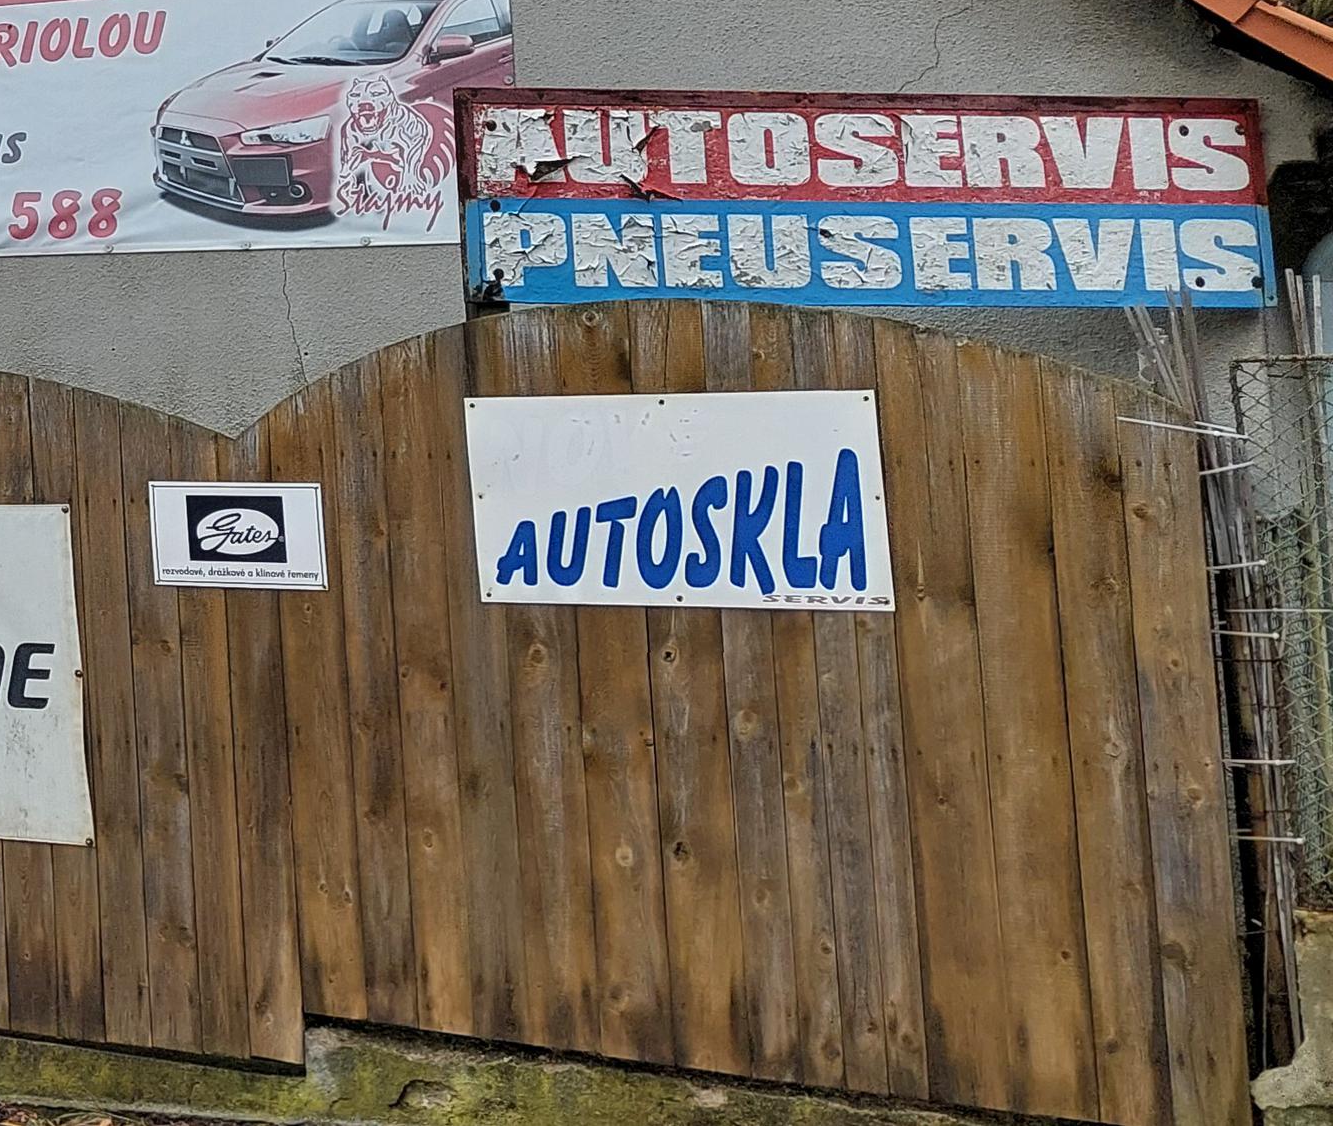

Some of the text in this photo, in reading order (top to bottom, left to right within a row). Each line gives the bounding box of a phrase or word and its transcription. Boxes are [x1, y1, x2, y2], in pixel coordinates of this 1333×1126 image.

[478, 107, 1256, 192] AUTOSERVIS
[8, 188, 122, 241] 588
[483, 210, 1261, 292] PNEUSERVIS
[199, 512, 279, 551] Gates
[495, 448, 869, 596] AUTOSKLA
[287, 569, 319, 581] řemeny
[762, 594, 891, 606] SERVIS
